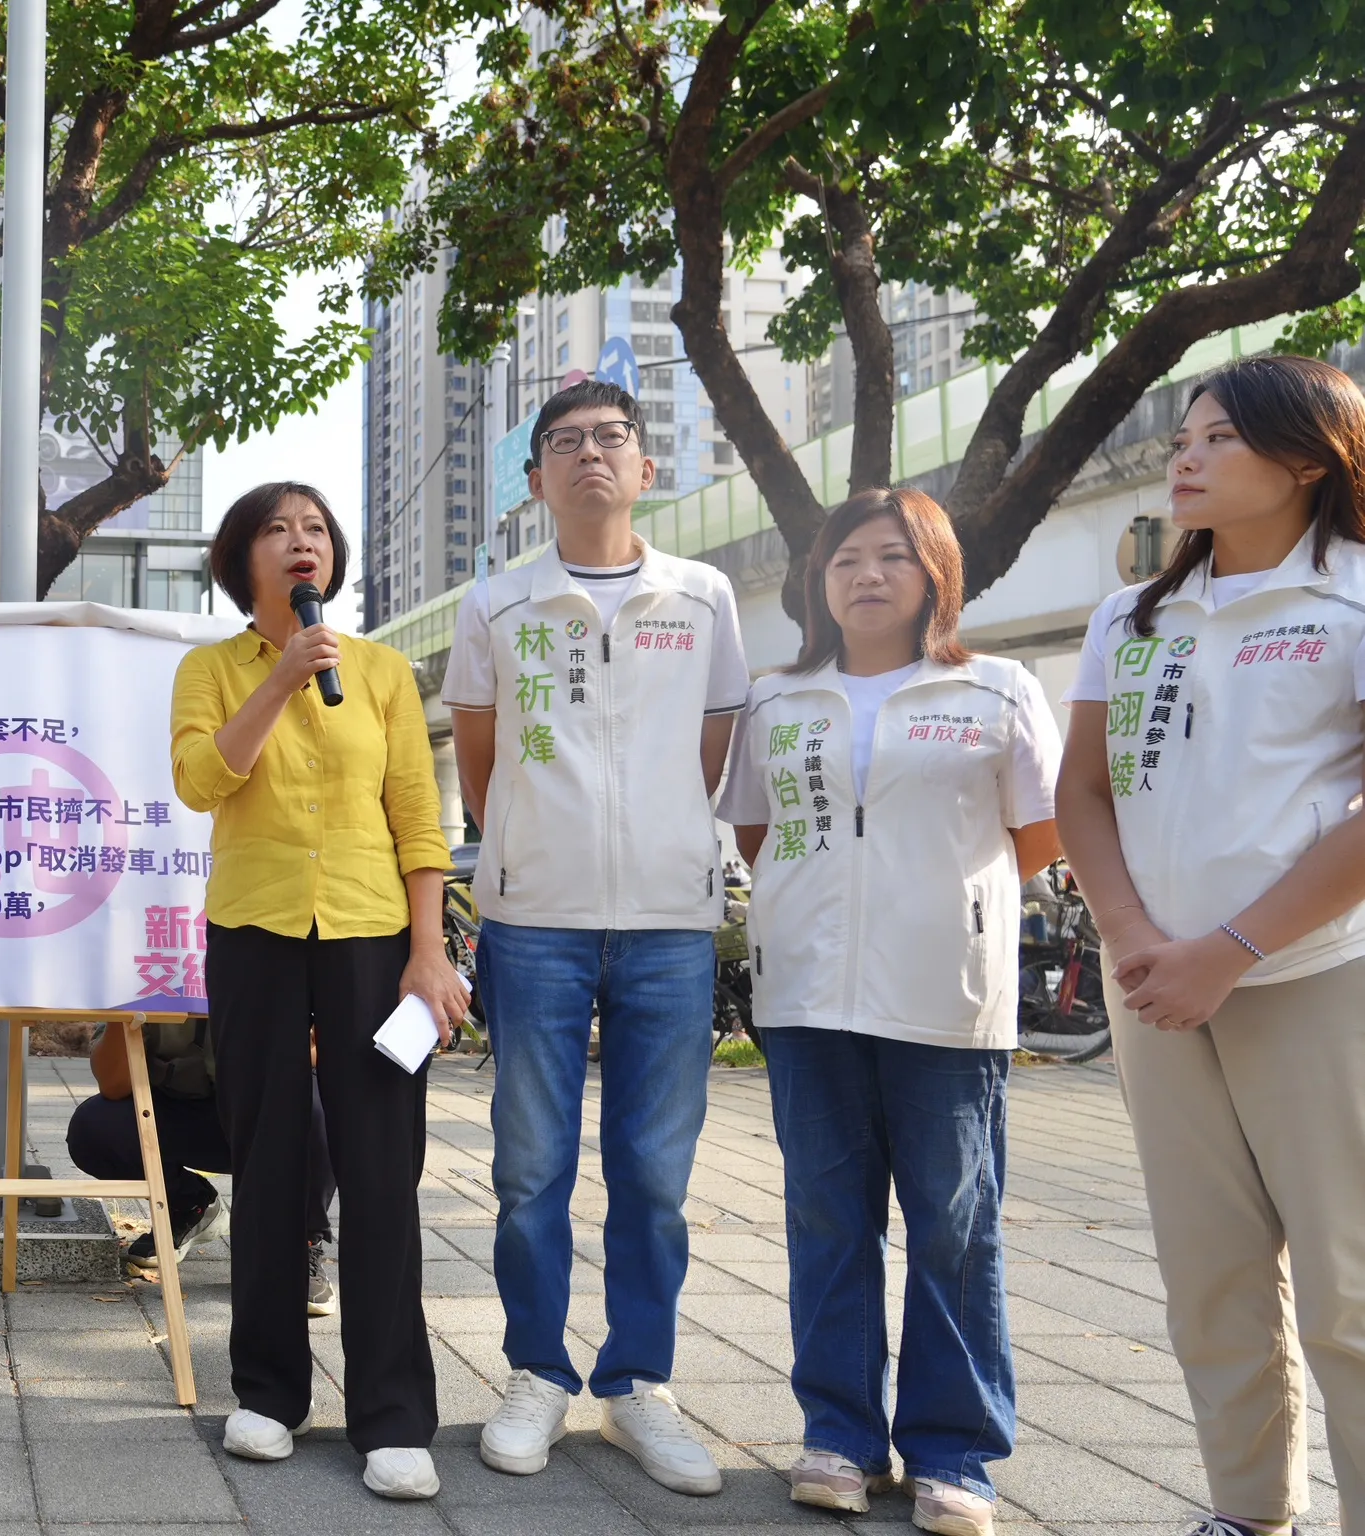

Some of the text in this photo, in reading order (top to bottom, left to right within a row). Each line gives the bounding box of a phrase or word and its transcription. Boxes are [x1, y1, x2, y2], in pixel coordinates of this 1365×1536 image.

[634, 631, 695, 650] 何欣純
[635, 620, 695, 630] 台中市長候選人
[1241, 624, 1329, 643] 台中市長候選人
[1233, 638, 1326, 667] 何欣純
[514, 622, 556, 765] 林祈烽
[569, 648, 586, 704] 市議員
[908, 724, 983, 747] 何欣純
[909, 714, 984, 726] 台中市長候選人
[1107, 637, 1164, 798] 何翊綾
[1139, 663, 1186, 791] 市議員參選人
[768, 721, 807, 862] 陳怡潔
[804, 739, 832, 851] 市議員參選人
